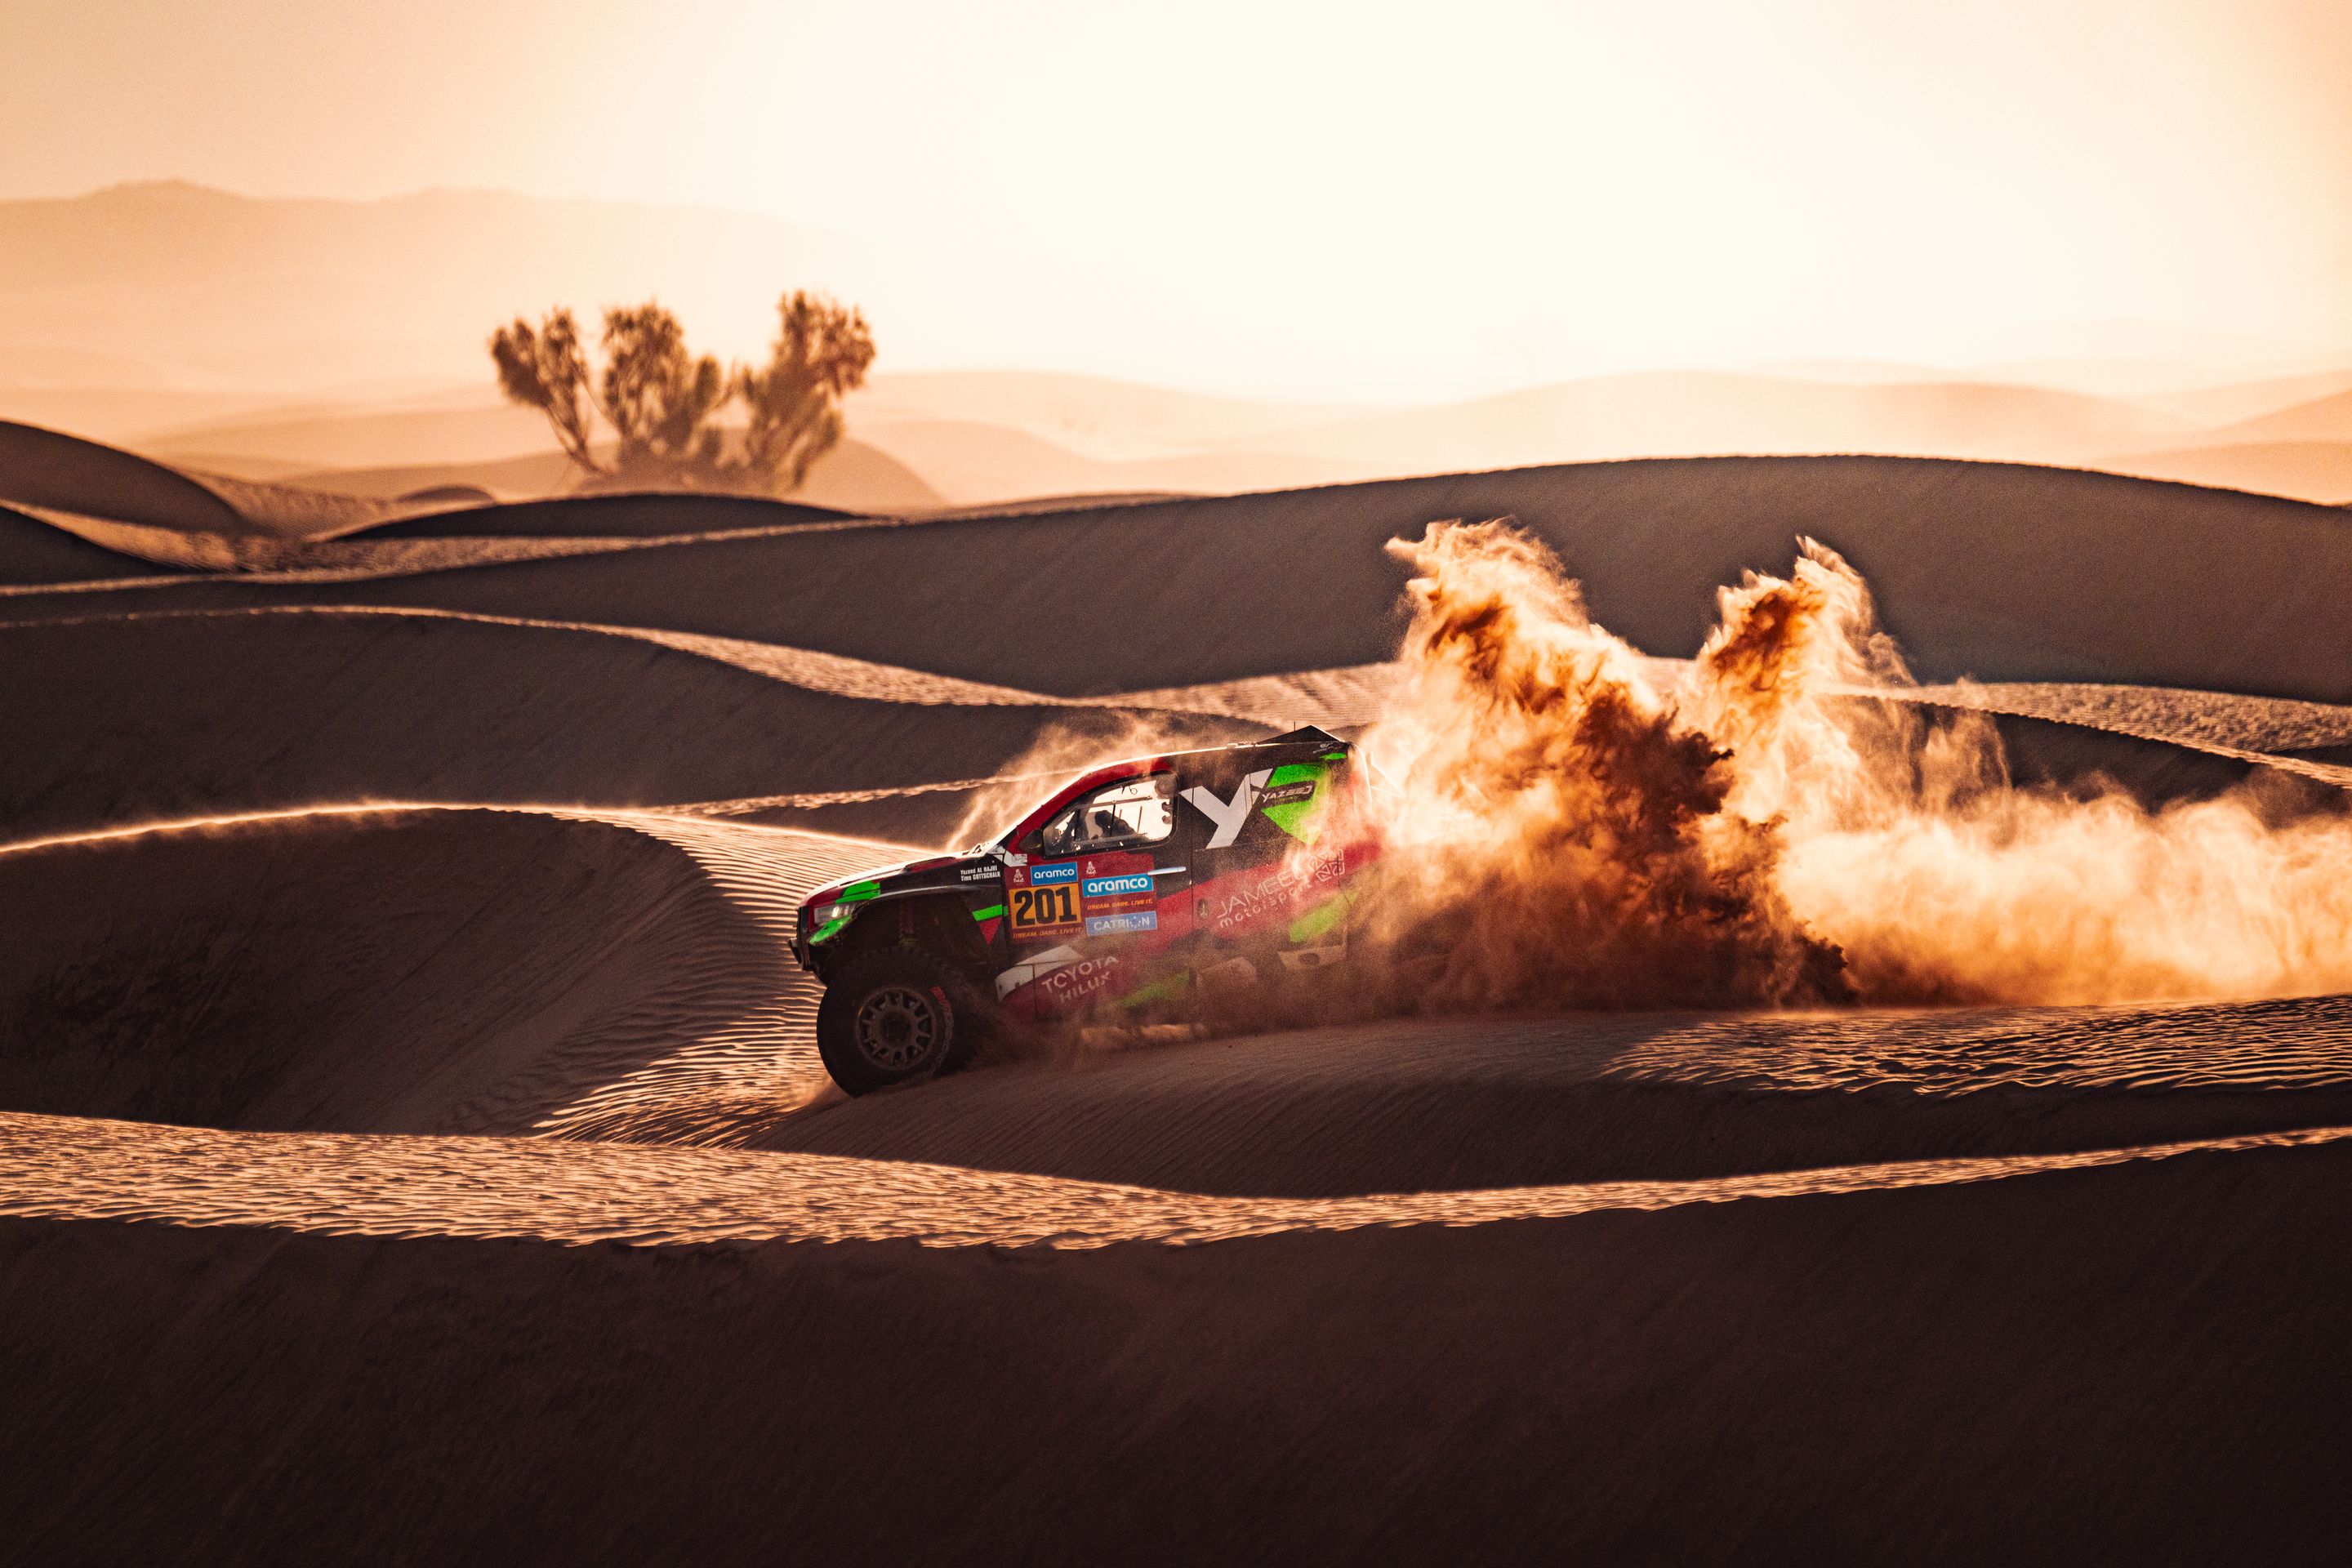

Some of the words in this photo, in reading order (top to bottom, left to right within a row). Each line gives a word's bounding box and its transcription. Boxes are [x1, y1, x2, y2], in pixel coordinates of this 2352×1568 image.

[1262, 785, 1312, 802] YAZEED
[973, 871, 1000, 880] GOTTSCHALK
[1034, 868, 1075, 879] aramco
[1088, 877, 1147, 893] aramco
[1014, 886, 1077, 927] 201
[1094, 915, 1150, 930] CATRION
[1041, 956, 1119, 993] TOYOTA
[1060, 971, 1111, 1003] HILUX
